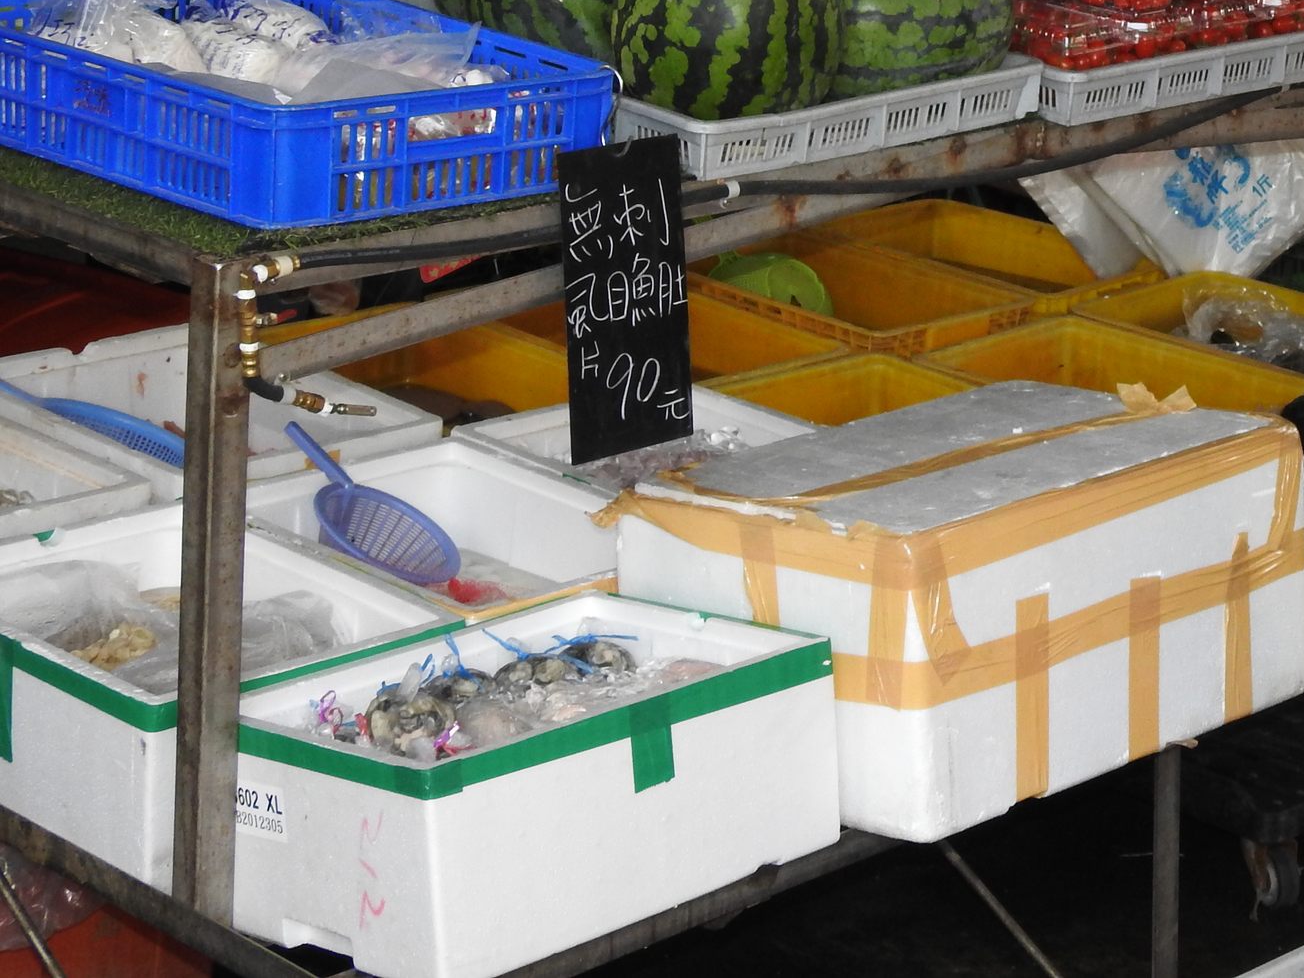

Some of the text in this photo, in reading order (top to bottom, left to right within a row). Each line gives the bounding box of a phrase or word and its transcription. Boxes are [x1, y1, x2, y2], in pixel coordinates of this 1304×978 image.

[1251, 174, 1274, 198] 1斤
[564, 177, 671, 263] 無刺
[265, 792, 283, 815] XL
